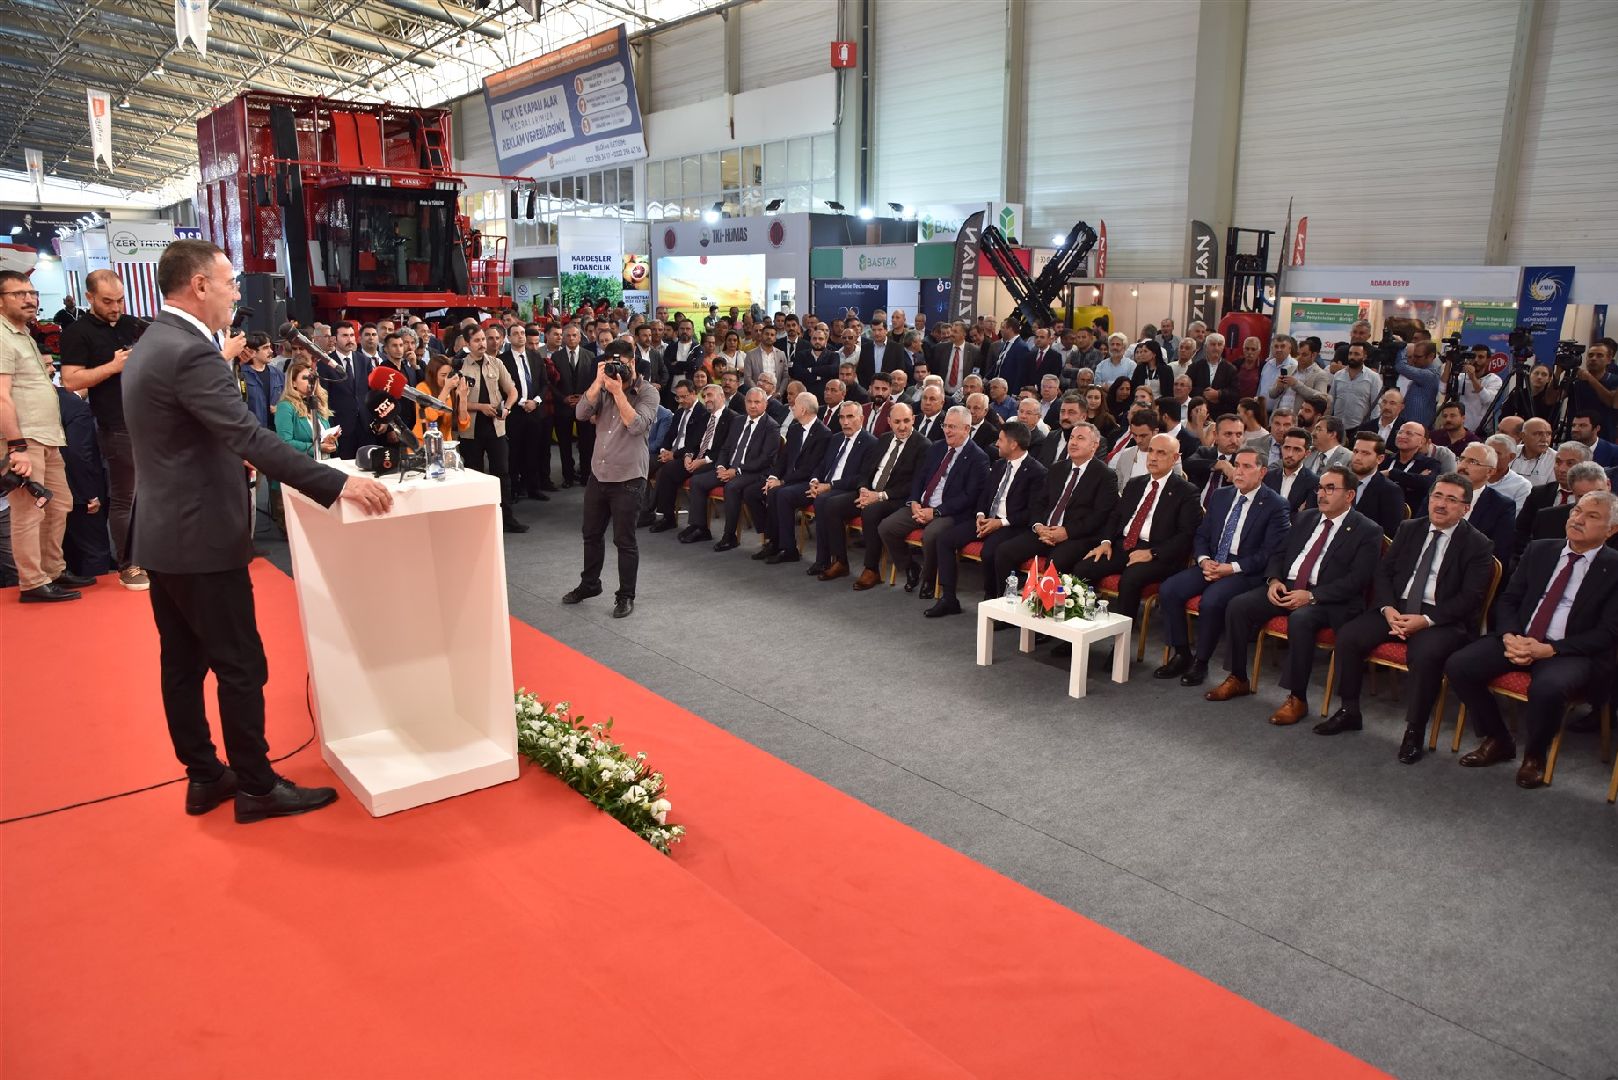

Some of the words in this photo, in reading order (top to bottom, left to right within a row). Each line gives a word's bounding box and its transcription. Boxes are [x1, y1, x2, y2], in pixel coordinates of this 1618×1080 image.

[502, 132, 526, 151] REKLAM
[571, 255, 612, 263] KARDEŞLER
[867, 257, 897, 267] BASTAK
[374, 398, 391, 413] TRT
